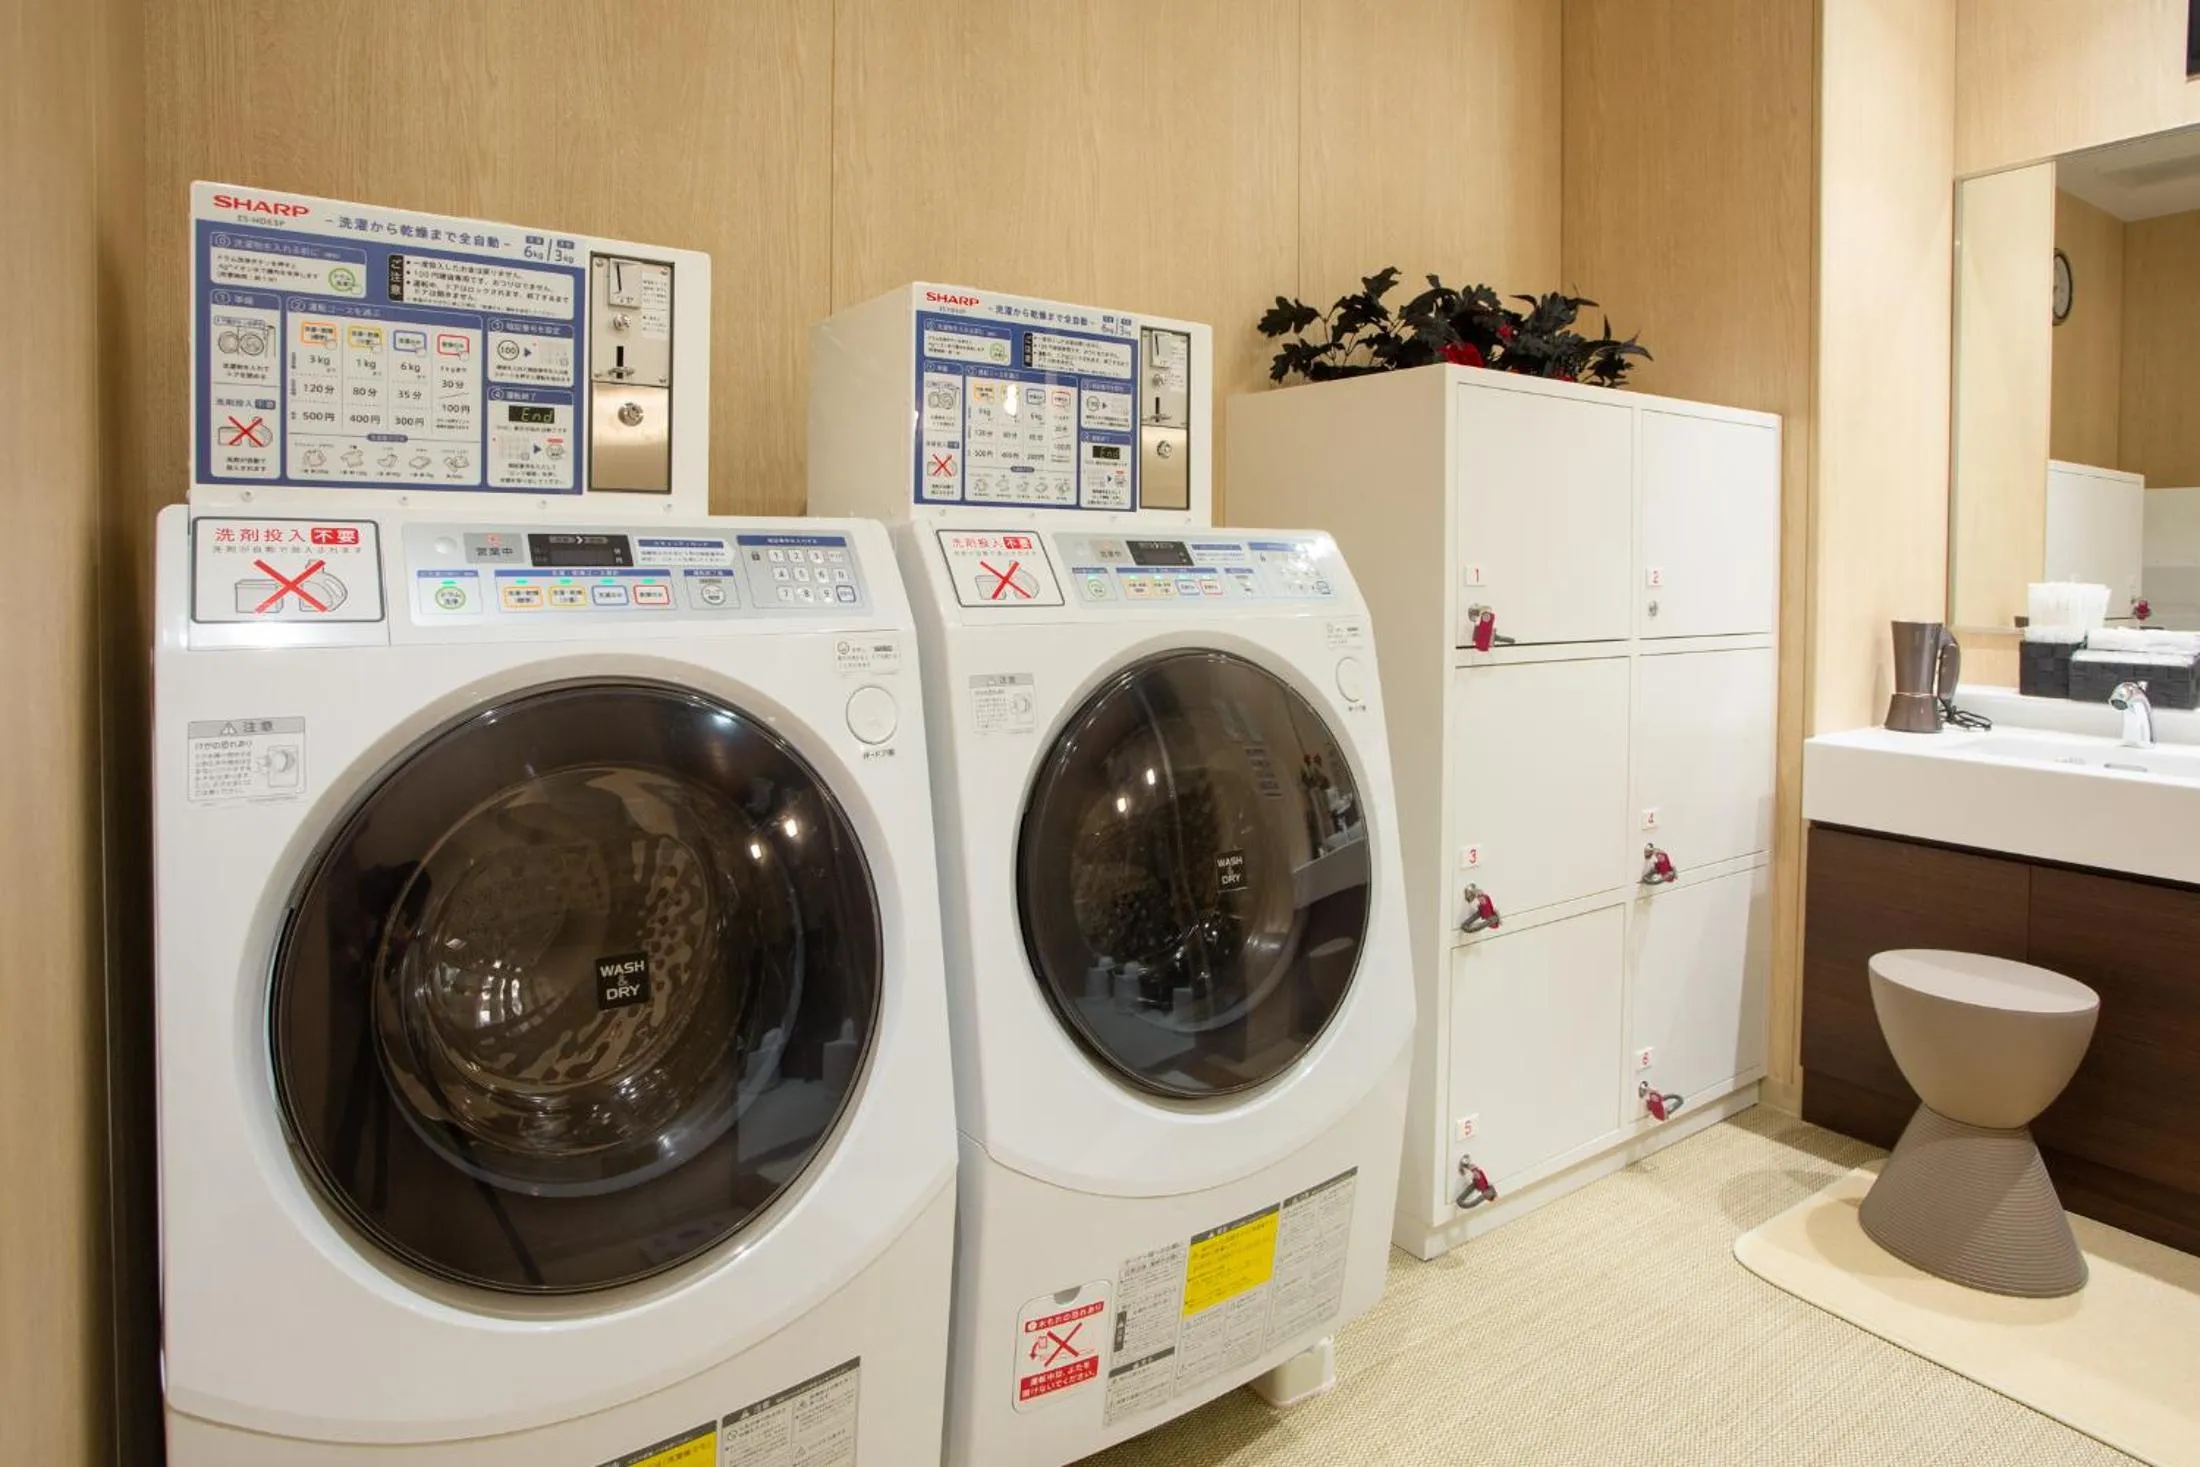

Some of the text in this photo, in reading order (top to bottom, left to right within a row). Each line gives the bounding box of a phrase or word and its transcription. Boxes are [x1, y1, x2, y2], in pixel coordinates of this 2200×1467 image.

[213, 195, 309, 217] SHARP
[926, 291, 980, 306] SHARP
[521, 408, 554, 423] End
[215, 528, 358, 544] 洗剤投入 不要
[1653, 570, 1659, 584] 2
[1217, 856, 1242, 867] WASH
[1469, 848, 1477, 864] 3
[600, 960, 645, 978] WASH
[606, 984, 640, 1001] DRY
[1464, 1120, 1472, 1135] 5
